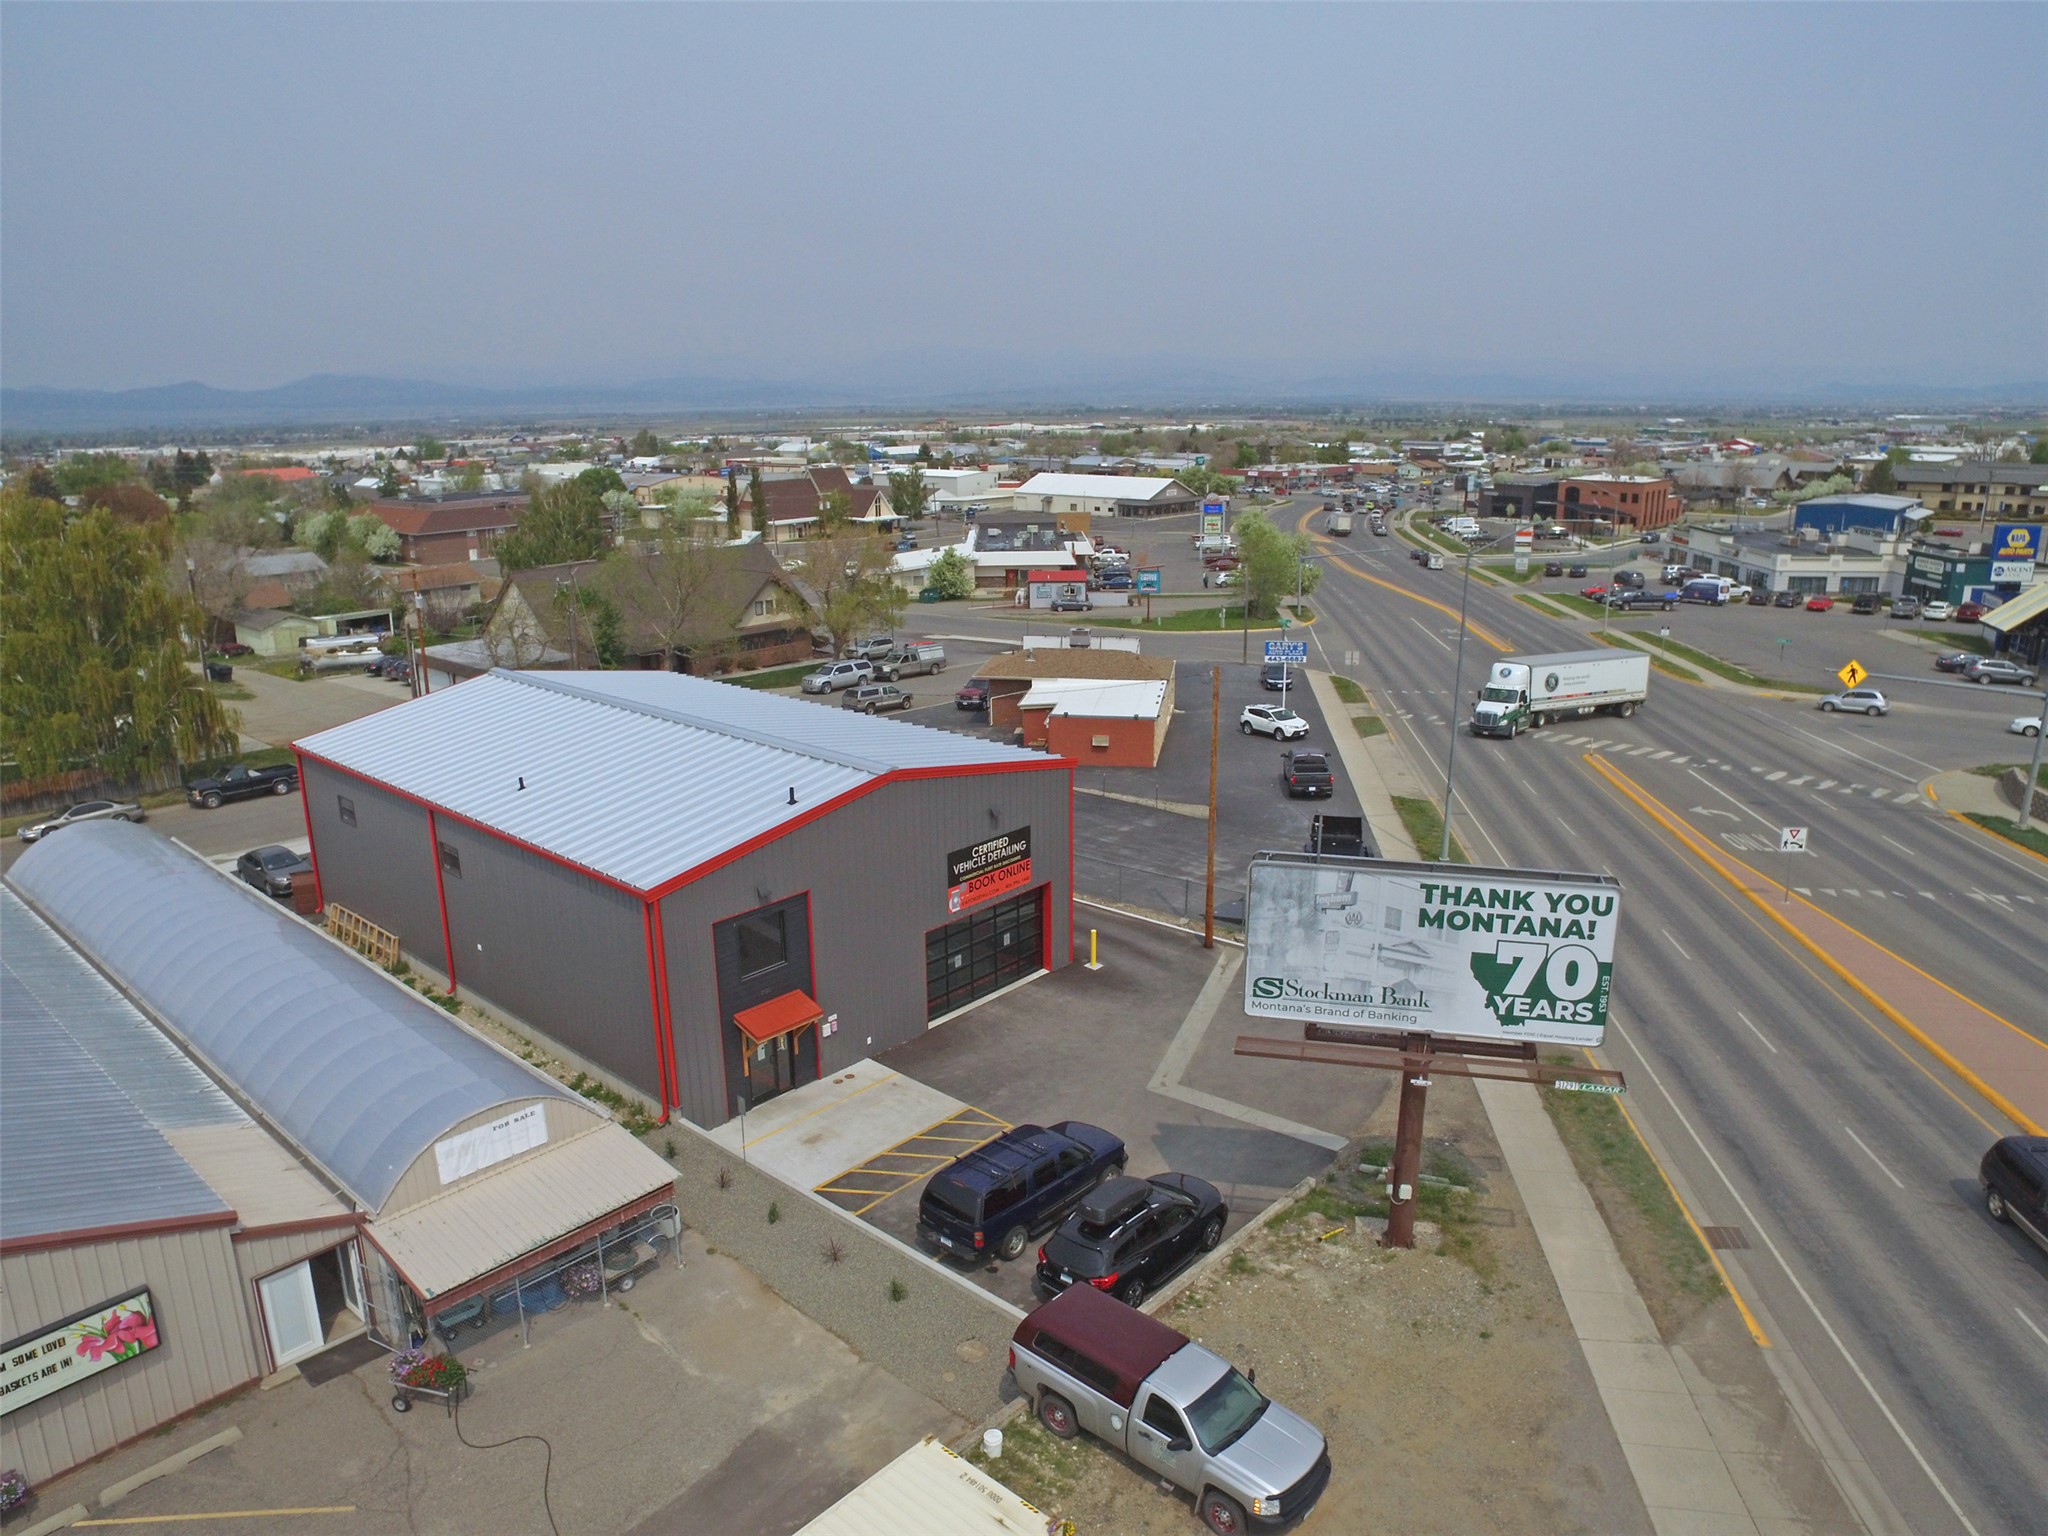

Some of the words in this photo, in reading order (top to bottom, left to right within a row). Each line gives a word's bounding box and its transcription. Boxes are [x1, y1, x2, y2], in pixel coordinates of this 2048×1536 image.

[2011, 533, 2026, 542] NAPA
[1268, 642, 1304, 650] GARY'S
[972, 837, 1009, 857] CERTIFIED
[1720, 833, 1781, 852] ONLY
[953, 855, 986, 875] VEHICLE
[987, 840, 1027, 862] DETAILING
[968, 873, 996, 893] BOOK
[998, 860, 1030, 881] ONLINE
[1420, 883, 1535, 911] THANK
[1544, 892, 1614, 917] YOU
[1418, 908, 1597, 940] MONTANA!
[1496, 940, 1599, 1001] 70
[1285, 979, 1373, 1004] Stockman
[1380, 986, 1430, 1008] Bank
[1600, 975, 1610, 993] EST.
[1251, 1000, 1311, 1014] Montana's
[1314, 1007, 1350, 1018] Brand
[1353, 1009, 1366, 1018] of
[1368, 1010, 1417, 1025] Banking
[1493, 995, 1593, 1022] YEARS
[1598, 994, 1608, 1013] 1953
[1582, 1084, 1621, 1094] LAMAR
[492, 1121, 510, 1131] FOR
[513, 1110, 536, 1123] SALE
[12, 1348, 39, 1367] SOME
[41, 1336, 66, 1355] LOVE!
[0, 1371, 39, 1397] BASKETS
[41, 1363, 58, 1378] ARE
[60, 1356, 73, 1370] IN!
